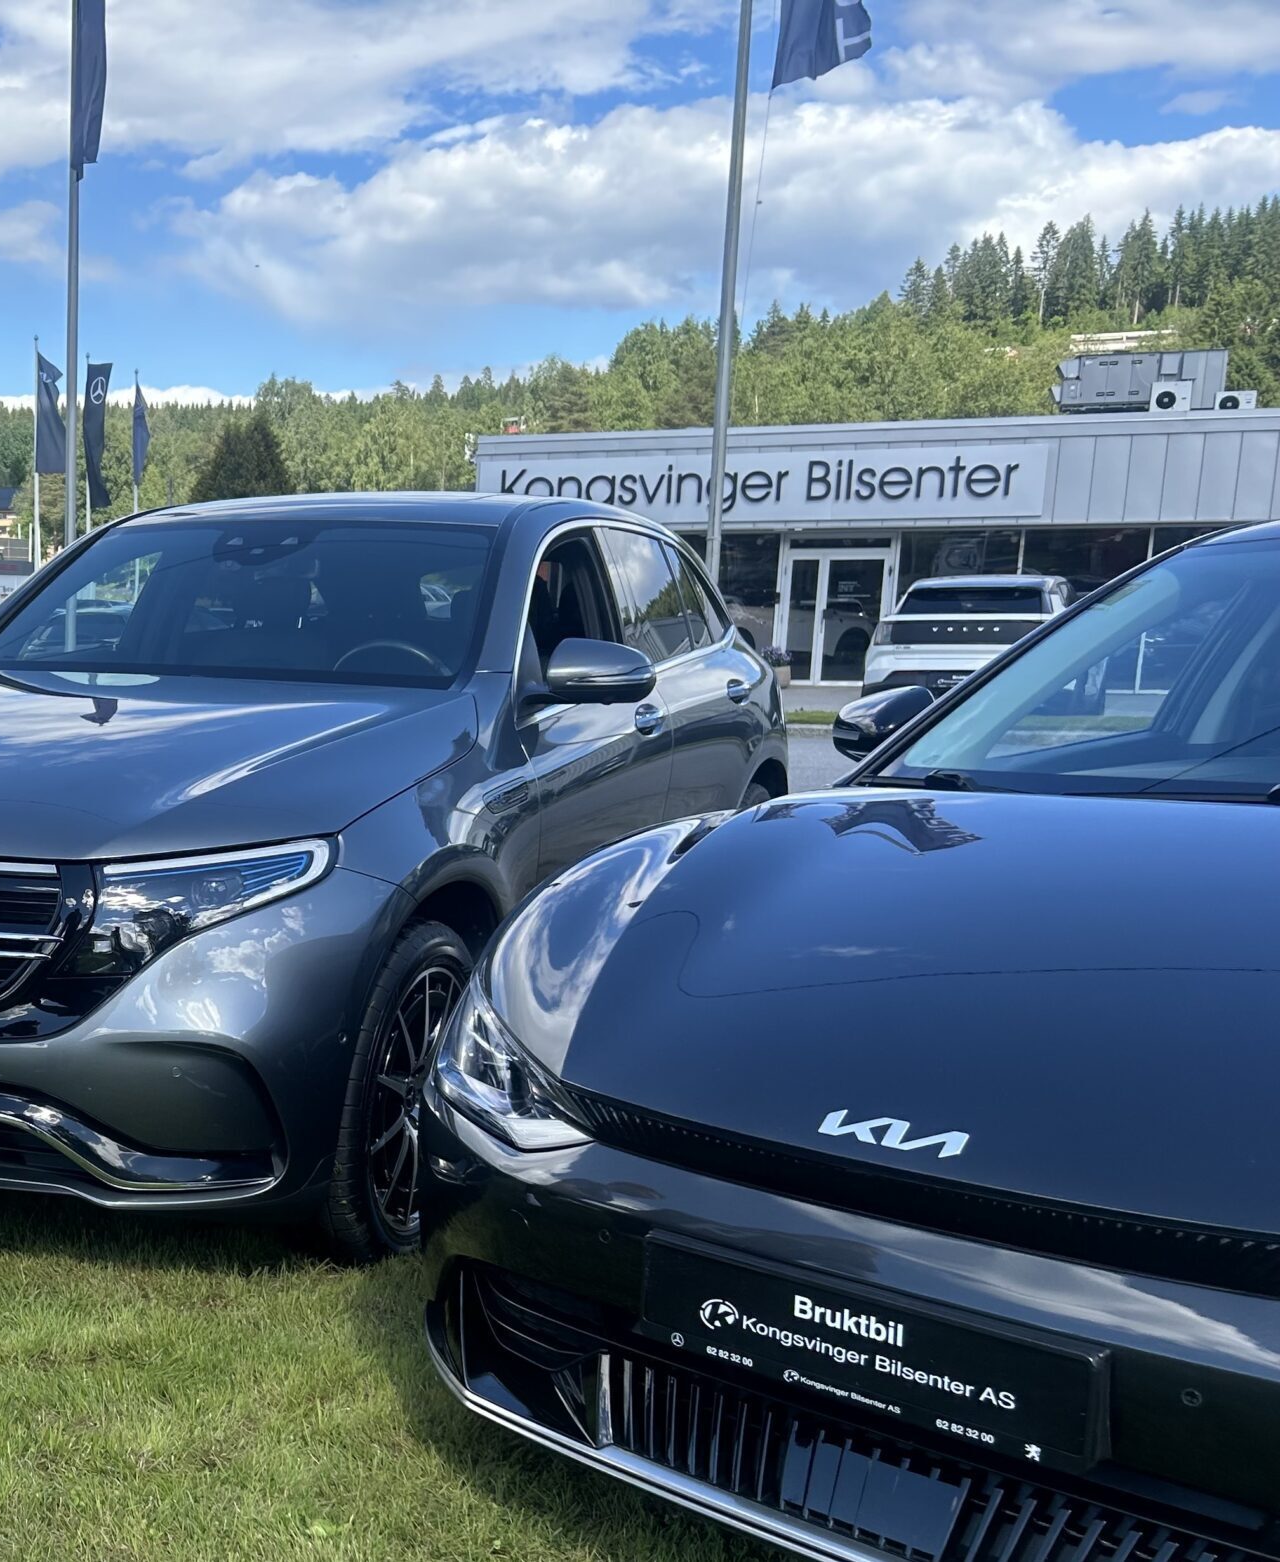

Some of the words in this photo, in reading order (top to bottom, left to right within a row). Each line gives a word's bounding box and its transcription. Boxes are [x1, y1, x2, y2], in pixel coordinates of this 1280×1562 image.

[805, 456, 1019, 502] Bilsenter
[793, 1295, 904, 1347] Bruktbil
[706, 1346, 717, 1356] 62
[718, 1350, 729, 1360] 82
[730, 1353, 741, 1364] 32
[742, 1357, 753, 1367] 00
[742, 1315, 868, 1366] Kongsvinger
[875, 1355, 974, 1397] Bilsenter
[979, 1387, 1016, 1409] AS
[800, 1376, 849, 1397] Kongsvinger
[851, 1392, 886, 1409] Bilsenter
[887, 1405, 901, 1414] AS
[936, 1419, 949, 1430] 62
[951, 1422, 964, 1435] 82
[965, 1428, 979, 1439] 32
[980, 1432, 995, 1444] 00
